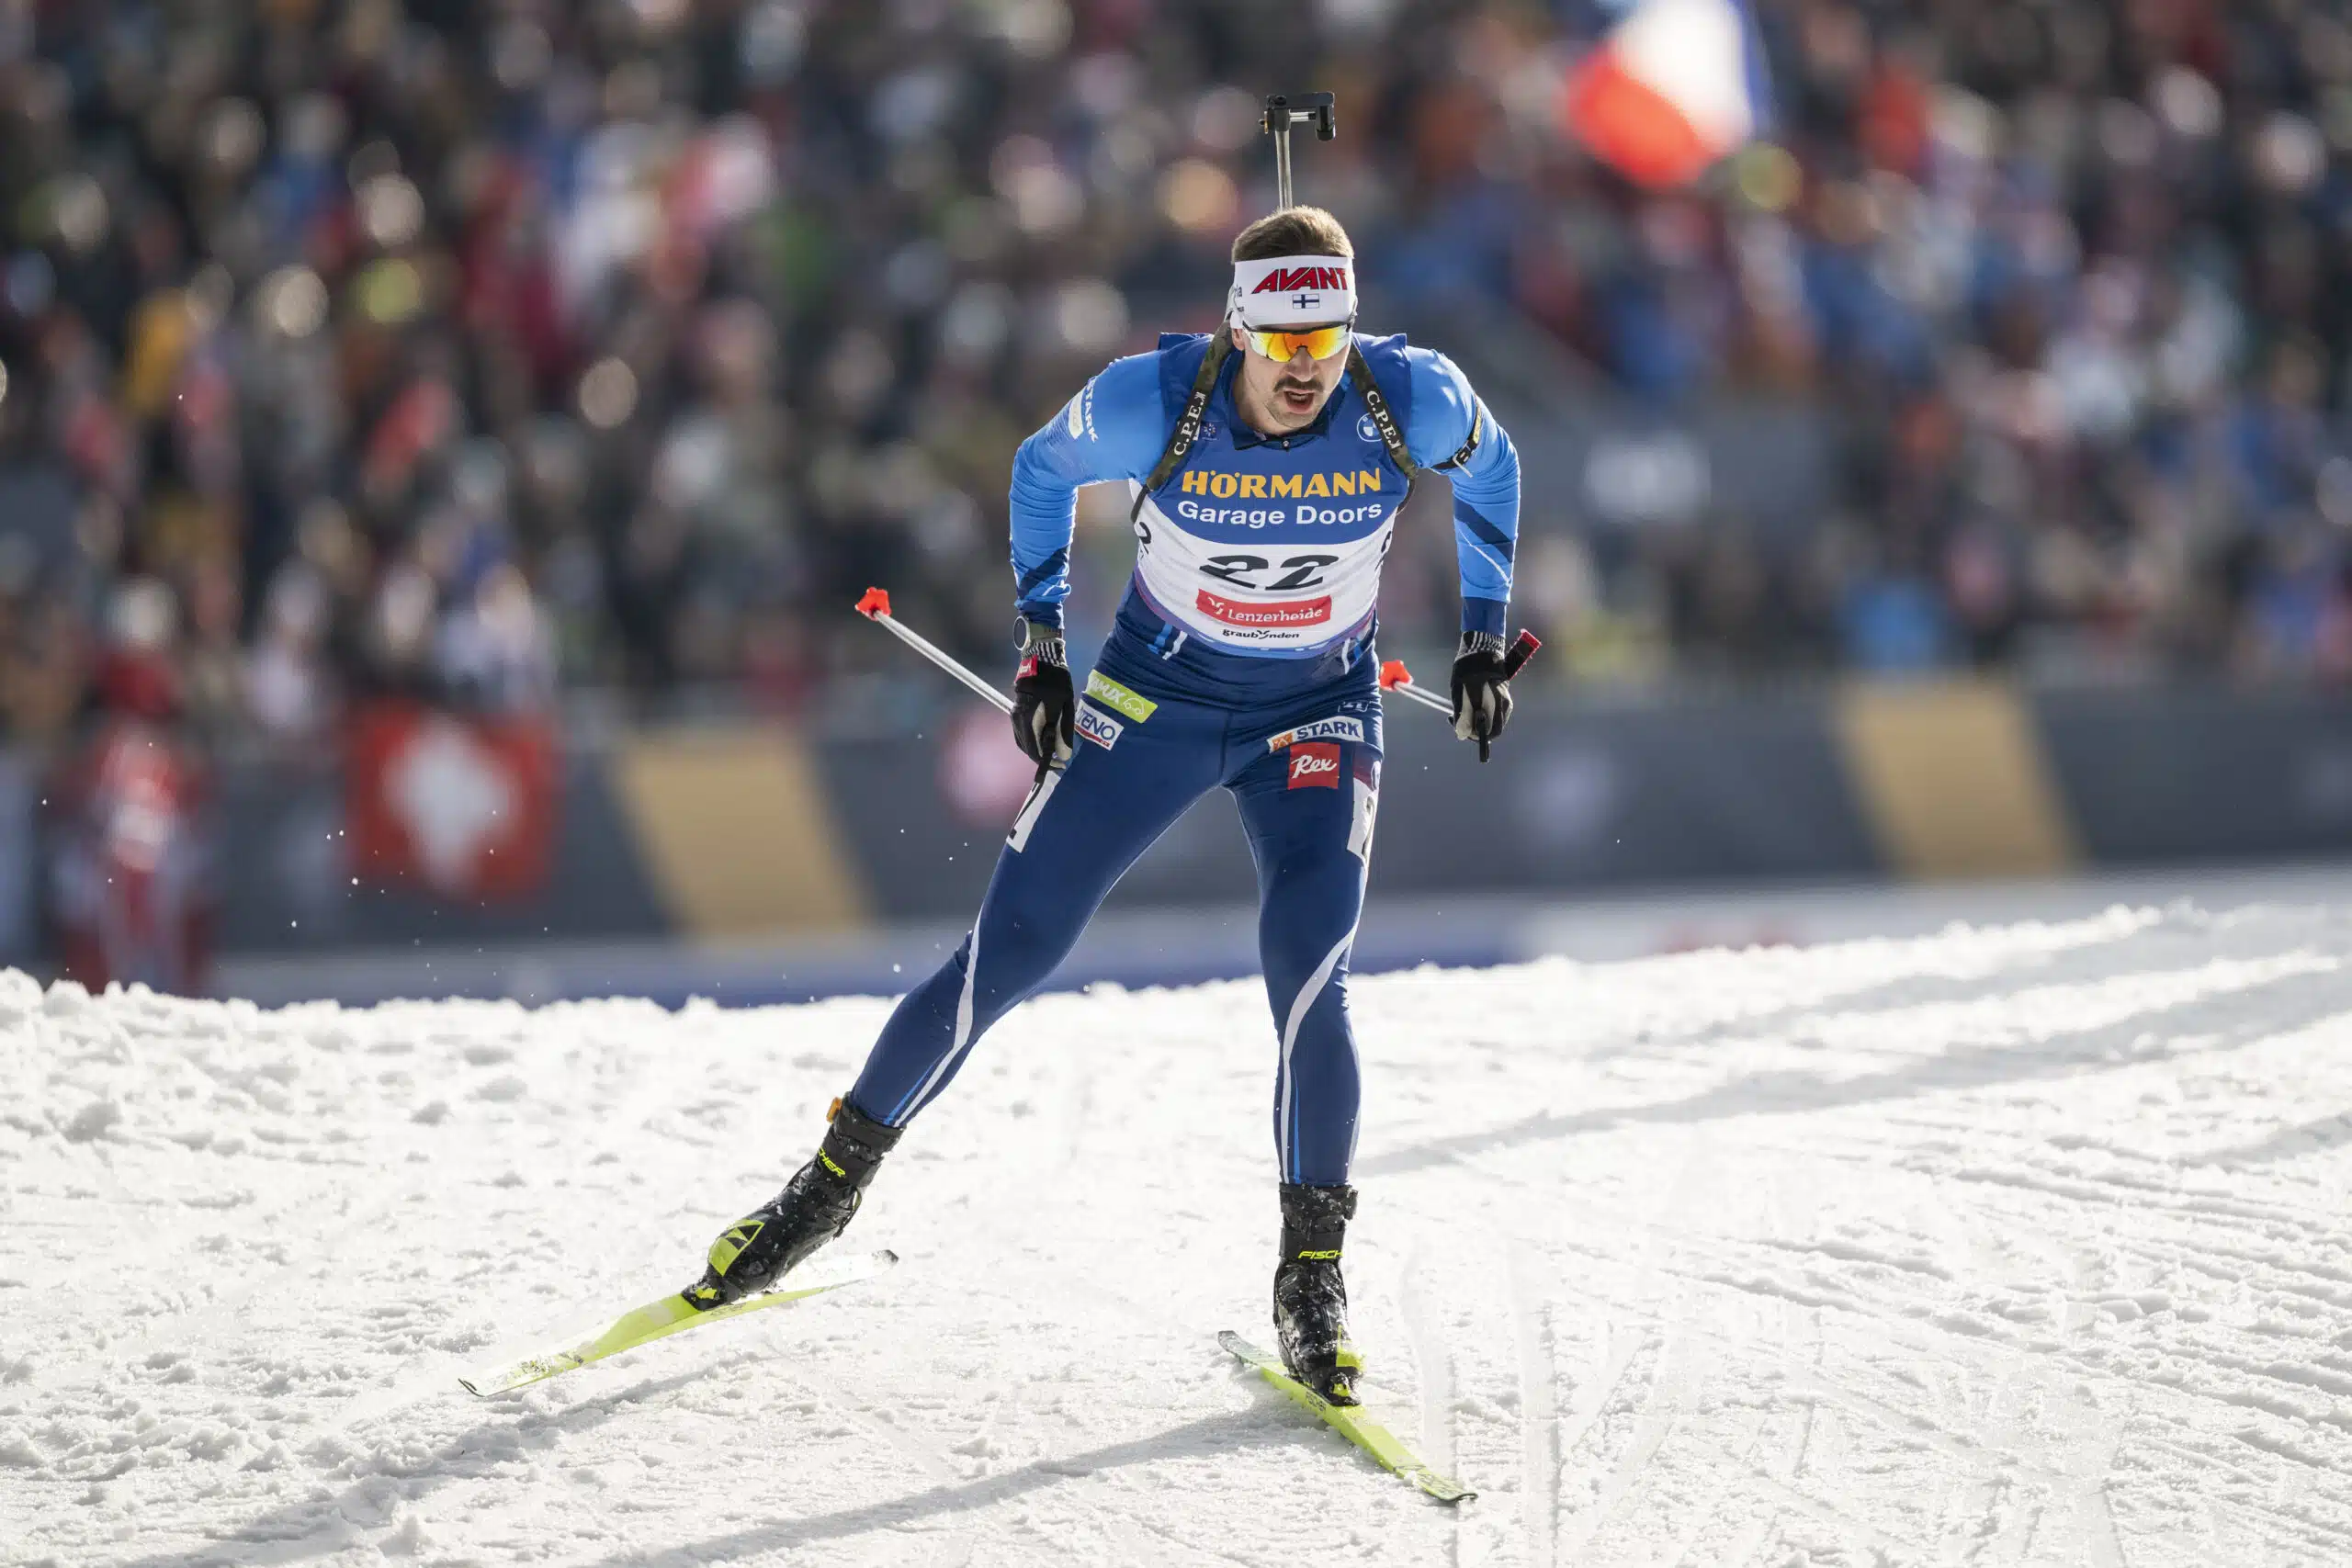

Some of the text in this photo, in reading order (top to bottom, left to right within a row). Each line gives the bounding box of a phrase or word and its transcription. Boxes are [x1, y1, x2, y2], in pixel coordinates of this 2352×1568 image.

[1251, 266, 1348, 295] AVANT
[1182, 468, 1382, 499] HÖRMANN
[1177, 501, 1383, 529] Garage Doors
[1199, 554, 1340, 591] 22
[1227, 607, 1323, 623] Lenzerheide
[1296, 721, 1362, 740] STARK
[1291, 754, 1338, 779] Rex
